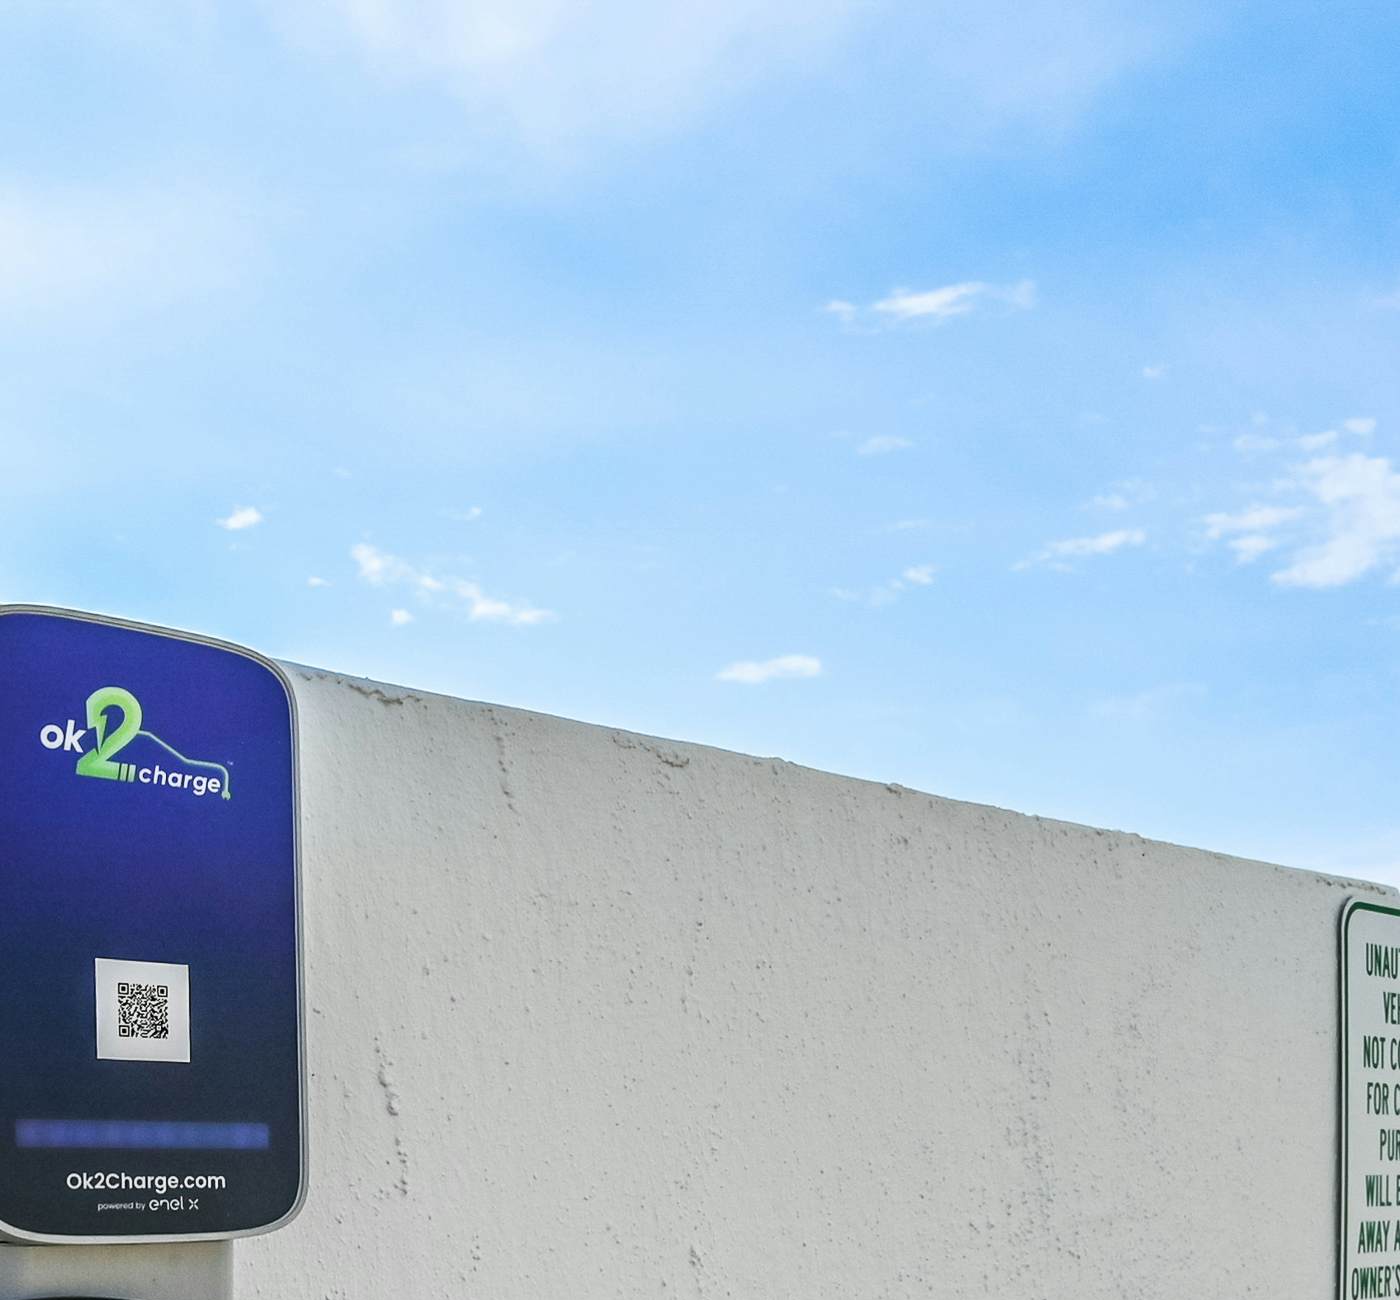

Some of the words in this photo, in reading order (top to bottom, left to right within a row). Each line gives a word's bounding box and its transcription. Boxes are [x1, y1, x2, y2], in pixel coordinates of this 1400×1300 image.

[138, 765, 221, 796] charge
[1366, 942, 1400, 979] UNAU
[1363, 1035, 1386, 1069] NOT
[1367, 1082, 1389, 1115] FOR
[66, 1172, 226, 1194] Ok2Charge.com
[1365, 1175, 1392, 1207] WILL
[97, 1201, 134, 1211] powered
[135, 1201, 146, 1211] by
[149, 1196, 184, 1211] enel
[1358, 1220, 1390, 1254] AWAY
[1351, 1264, 1400, 1300] OWNER'S
